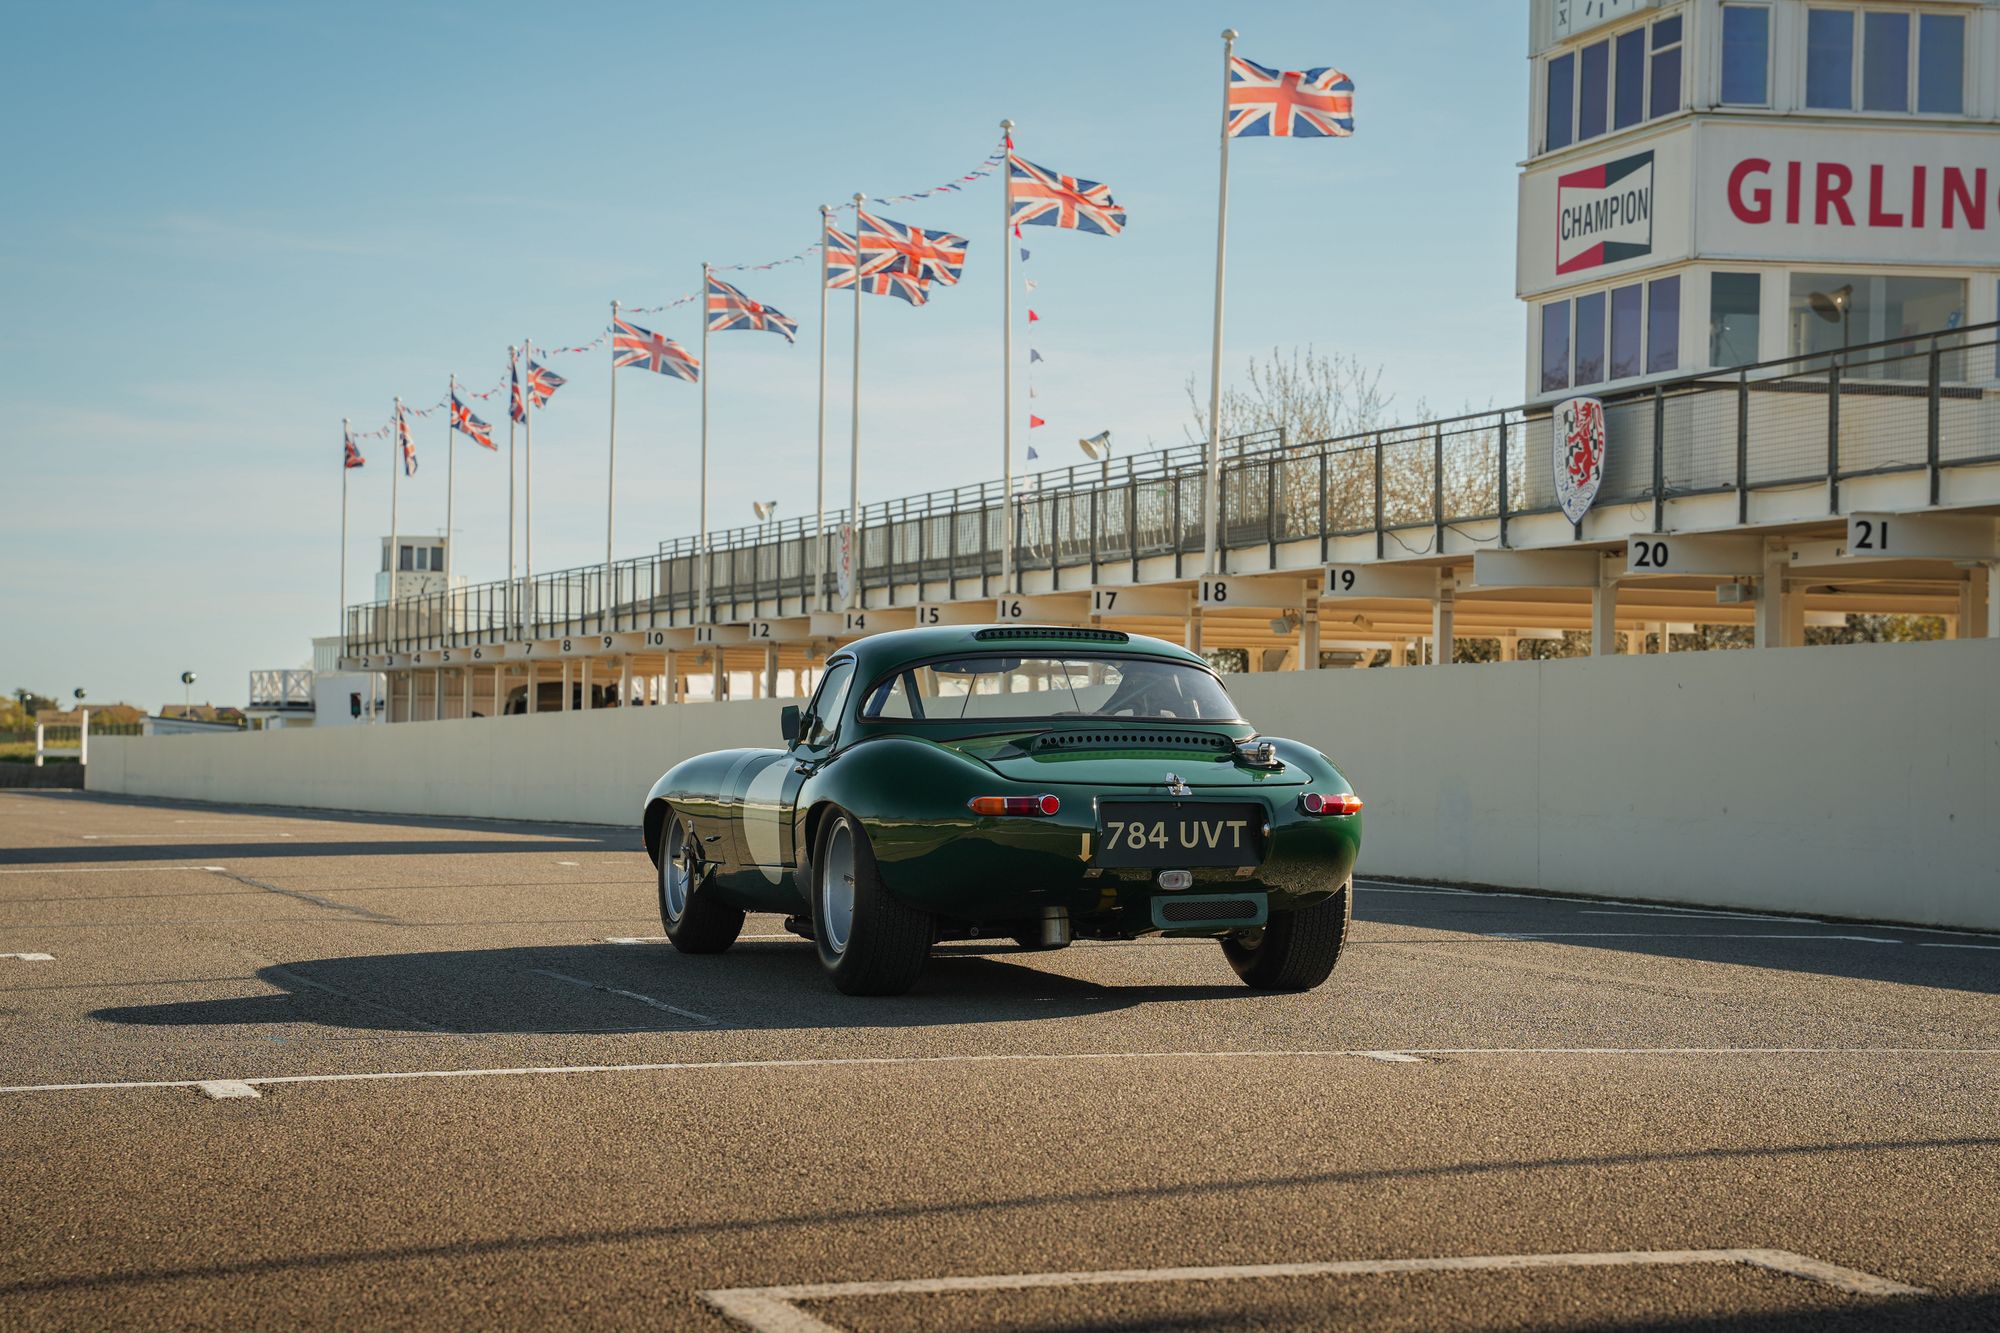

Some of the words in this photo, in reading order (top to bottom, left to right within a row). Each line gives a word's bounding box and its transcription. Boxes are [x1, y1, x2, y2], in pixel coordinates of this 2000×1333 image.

[1727, 157, 2000, 230] GIRLIN
[1561, 187, 1648, 241] CHAMPION
[1854, 521, 1888, 549] 21
[1634, 541, 1669, 567] 20
[1330, 569, 1355, 591] 19
[1203, 582, 1227, 602] 18
[1095, 591, 1117, 610] 17
[920, 607, 939, 623] 15
[1001, 601, 1022, 617] 16
[847, 614, 865, 629] 14
[698, 628, 712, 641] 11
[753, 623, 770, 637] 12
[563, 640, 571, 651] 8
[604, 636, 612, 648] 9
[647, 632, 663, 645] 10
[474, 648, 482, 659] 6
[525, 643, 532, 654] 7
[363, 658, 369, 667] 2
[387, 656, 393, 666] 3
[414, 654, 421, 663] 4
[443, 651, 450, 661] 5
[1106, 821, 1169, 849] 784
[1179, 820, 1248, 848] UVT
